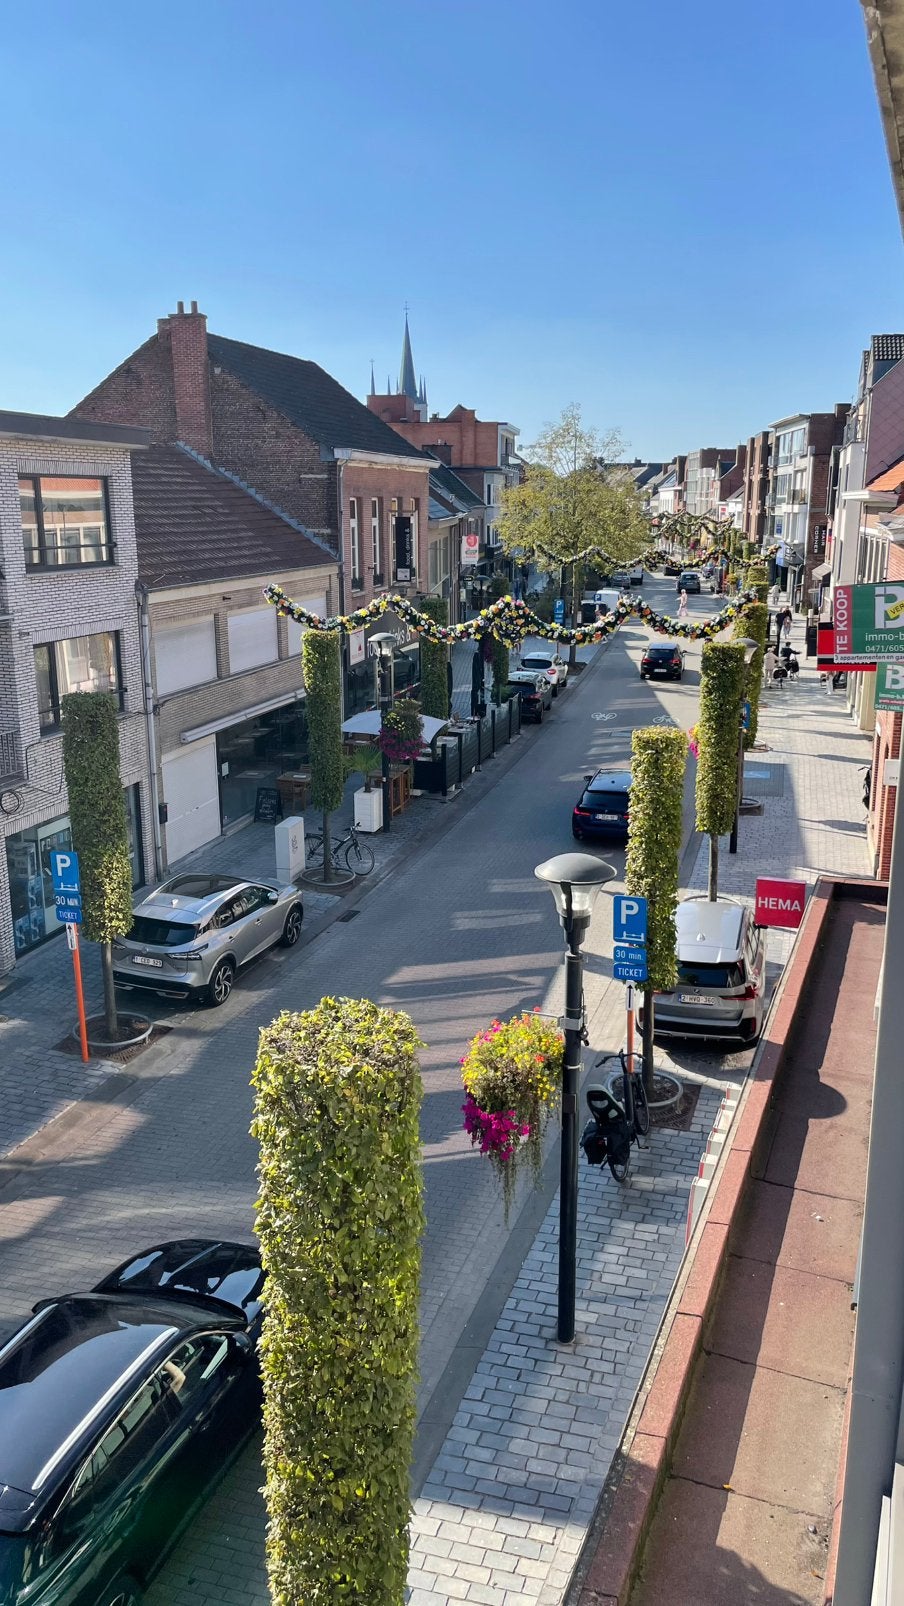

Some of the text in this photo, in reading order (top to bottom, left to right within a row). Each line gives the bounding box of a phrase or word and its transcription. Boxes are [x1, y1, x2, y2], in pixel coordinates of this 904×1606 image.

[836, 589, 848, 653] TE KOOP
[840, 653, 886, 661] appartementen
[55, 854, 71, 877] P
[55, 895, 66, 905] 30
[757, 896, 802, 912] HEMA
[58, 910, 78, 920] TICKET
[620, 899, 639, 925] P
[615, 949, 626, 959] 30
[617, 967, 643, 977] TICKET
